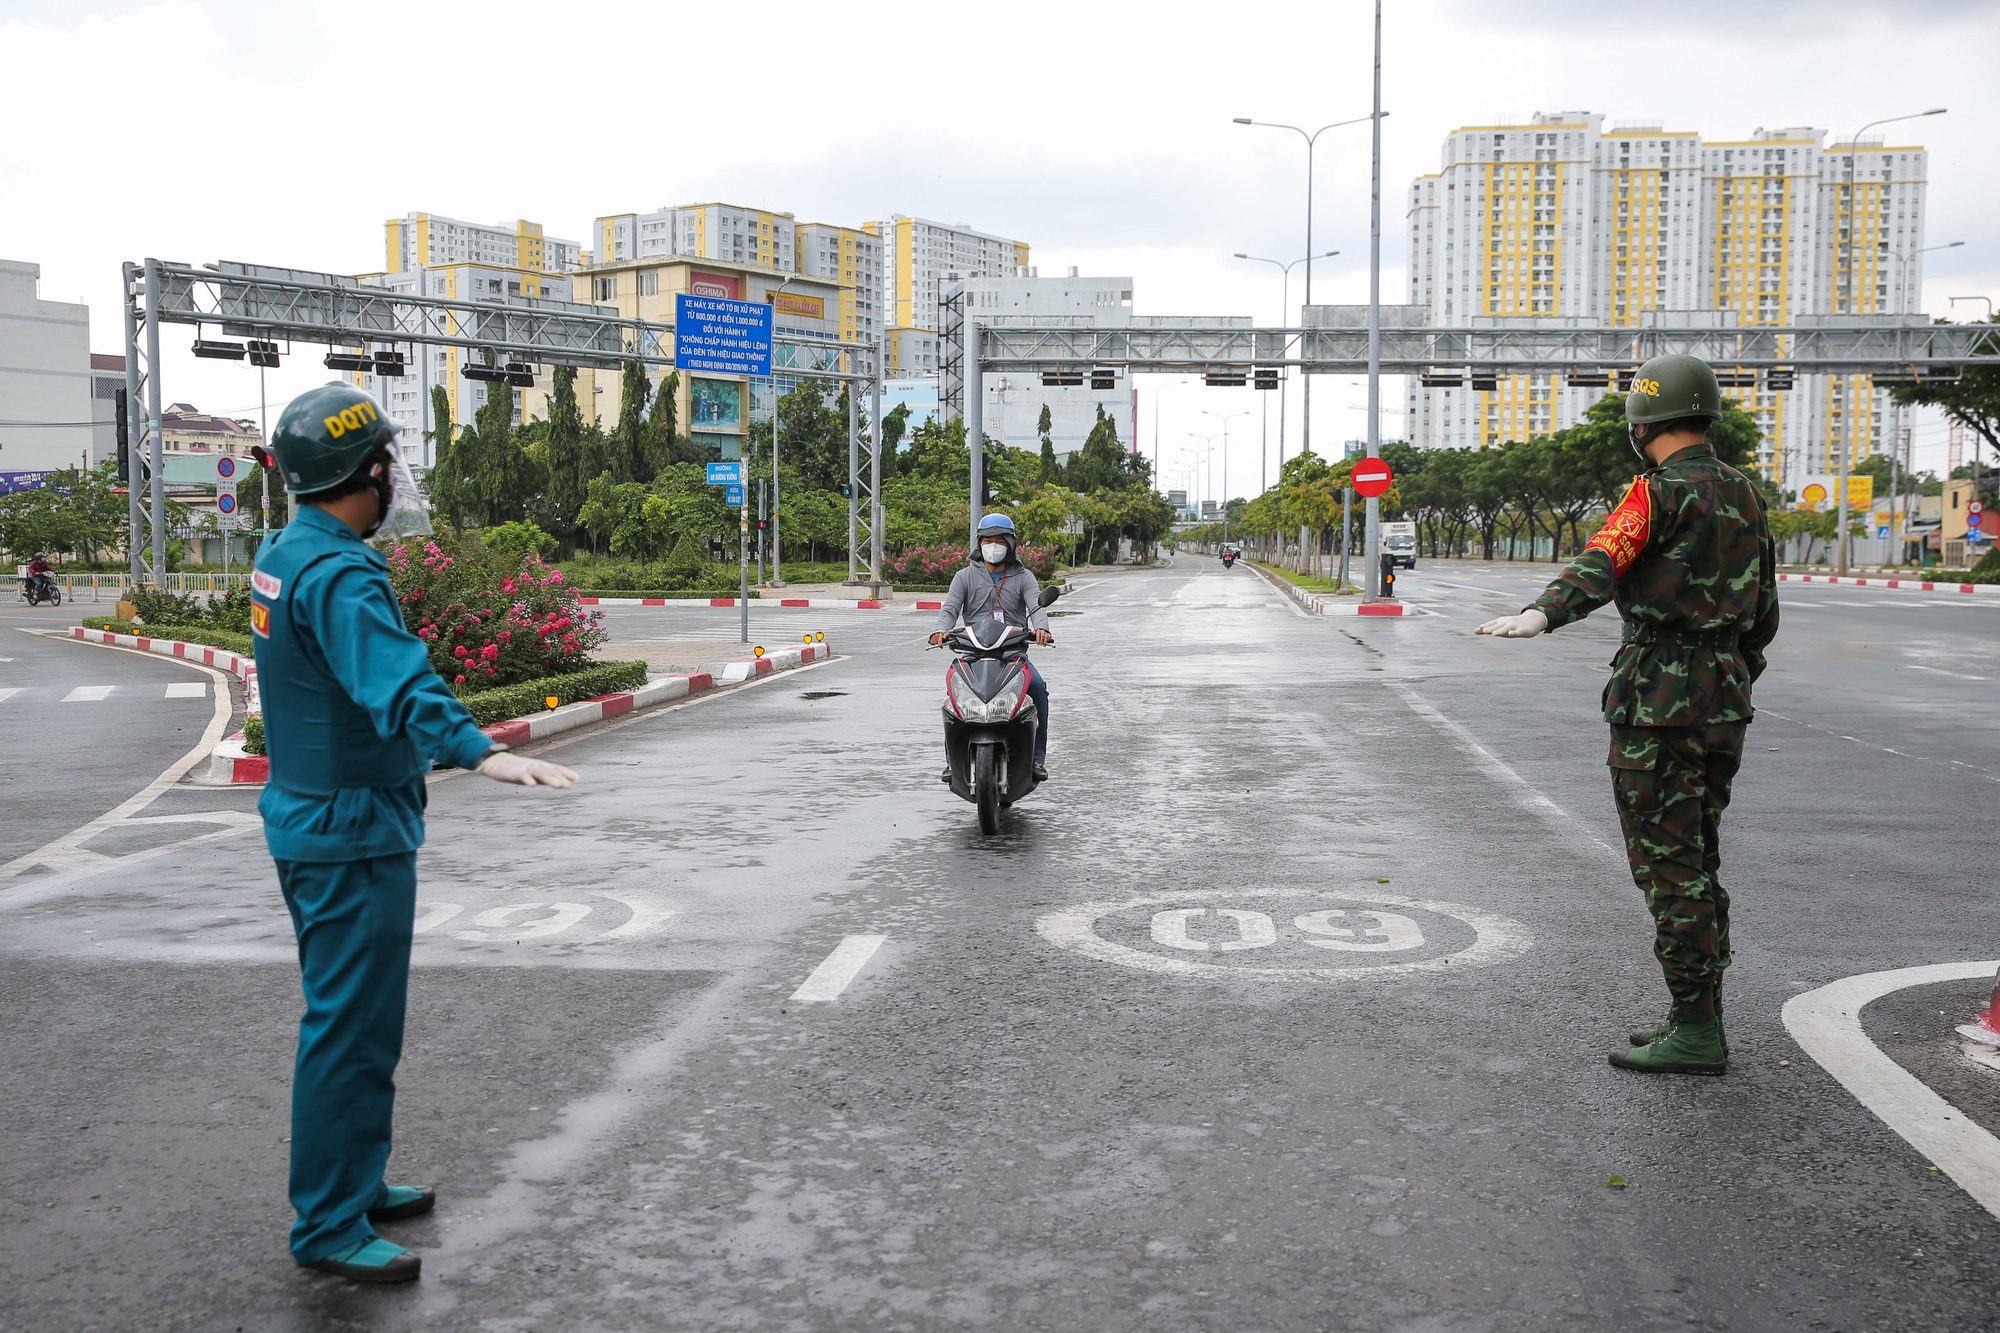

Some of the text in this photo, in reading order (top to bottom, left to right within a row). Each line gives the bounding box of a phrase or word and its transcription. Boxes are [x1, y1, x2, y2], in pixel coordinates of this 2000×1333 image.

[696, 286, 724, 298] OSHIMA
[685, 299, 693, 308] XE
[708, 302, 716, 310] XE
[716, 302, 726, 311] MÔ
[726, 303, 734, 312] TÔ
[734, 304, 740, 314] BỊ
[740, 304, 748, 314] XỬ
[749, 306, 764, 317] PHẠT
[687, 310, 696, 320] TỪ
[722, 313, 734, 324] ĐẾN
[735, 316, 758, 326] 1.000.000
[703, 323, 748, 337] ĐỐI VỚI HÀNH VI
[704, 336, 720, 346] CHẤP
[721, 338, 738, 348] HÀNH
[738, 340, 752, 350] HIỆU
[752, 341, 768, 351] LỆNH
[680, 345, 693, 355] CỦA
[693, 346, 706, 356] ĐÈN
[706, 348, 717, 357] TÍN
[717, 350, 731, 359] HIỆU
[731, 351, 745, 360] GIAO
[324, 401, 377, 438] DQTV
[1620, 536, 1636, 561] SOÁT
